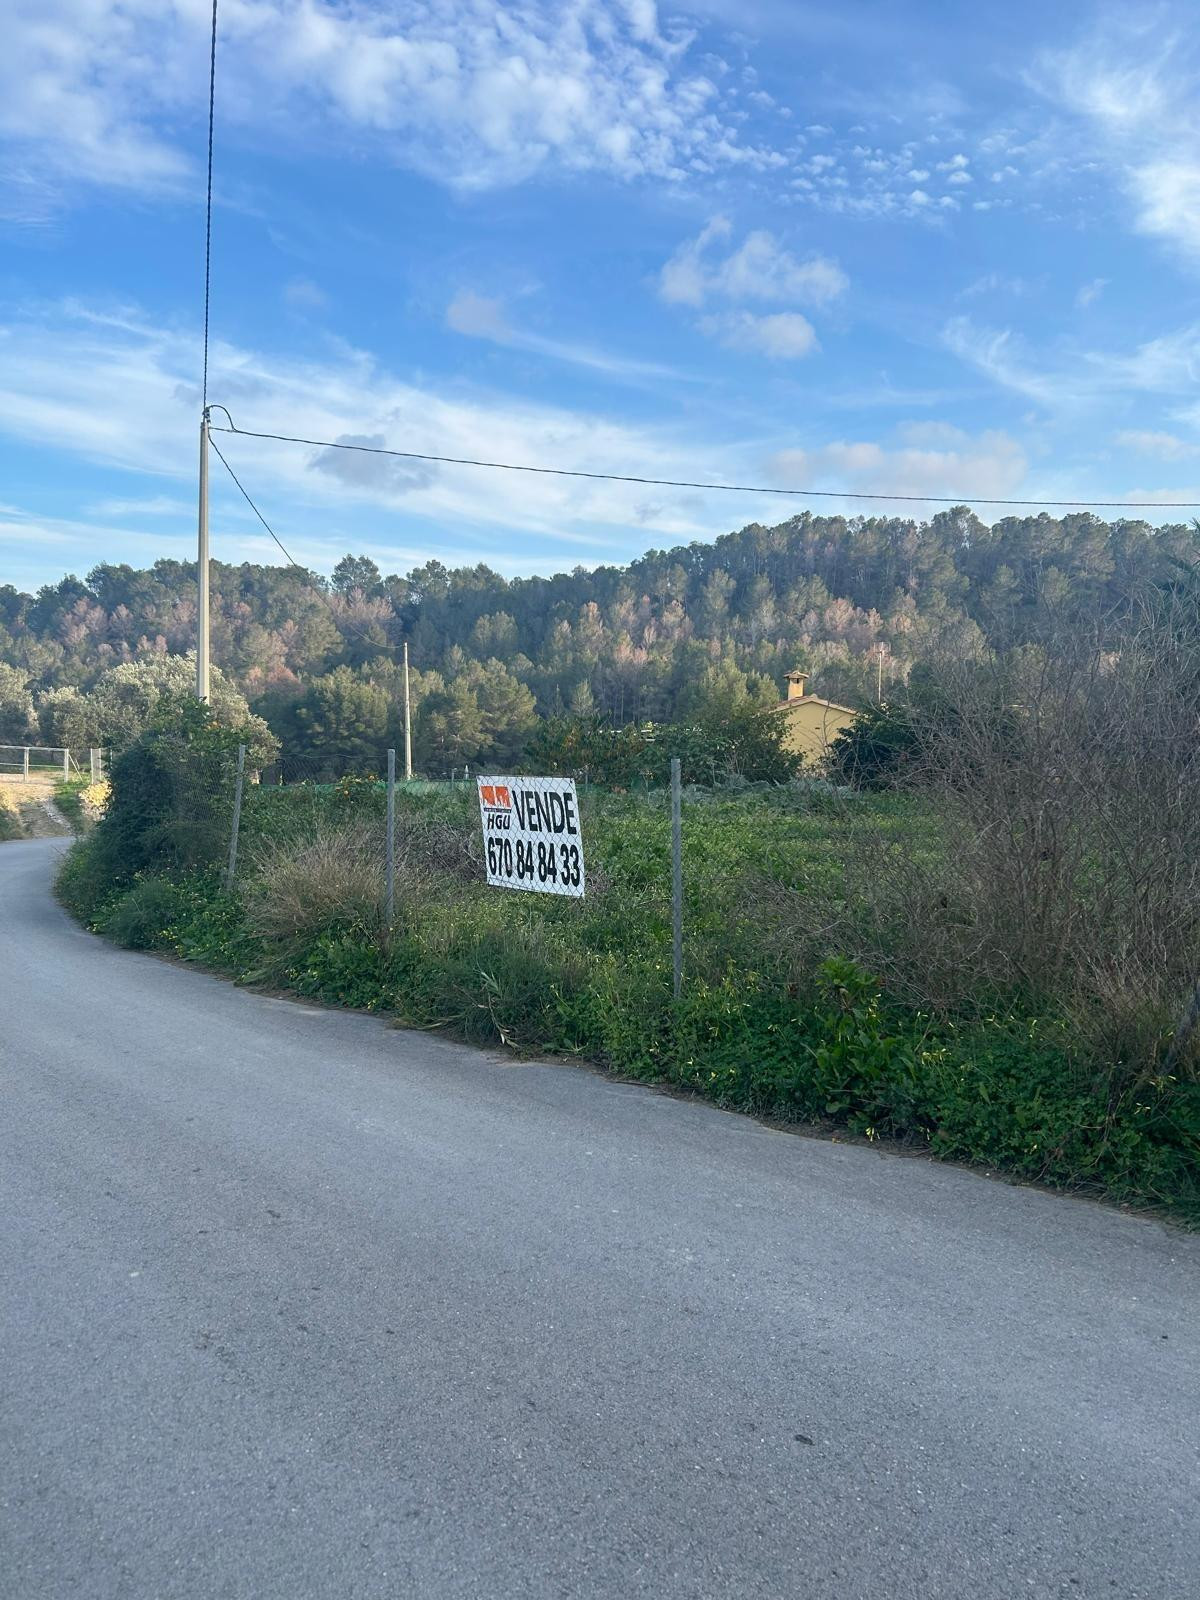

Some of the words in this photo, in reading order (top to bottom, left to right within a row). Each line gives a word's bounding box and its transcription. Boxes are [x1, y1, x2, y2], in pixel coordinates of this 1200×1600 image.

[487, 813, 511, 830] HGU
[512, 790, 577, 834] VENDE
[487, 837, 513, 878] 670
[516, 839, 534, 880] 84
[537, 841, 557, 883] 84
[560, 843, 580, 887] 33
